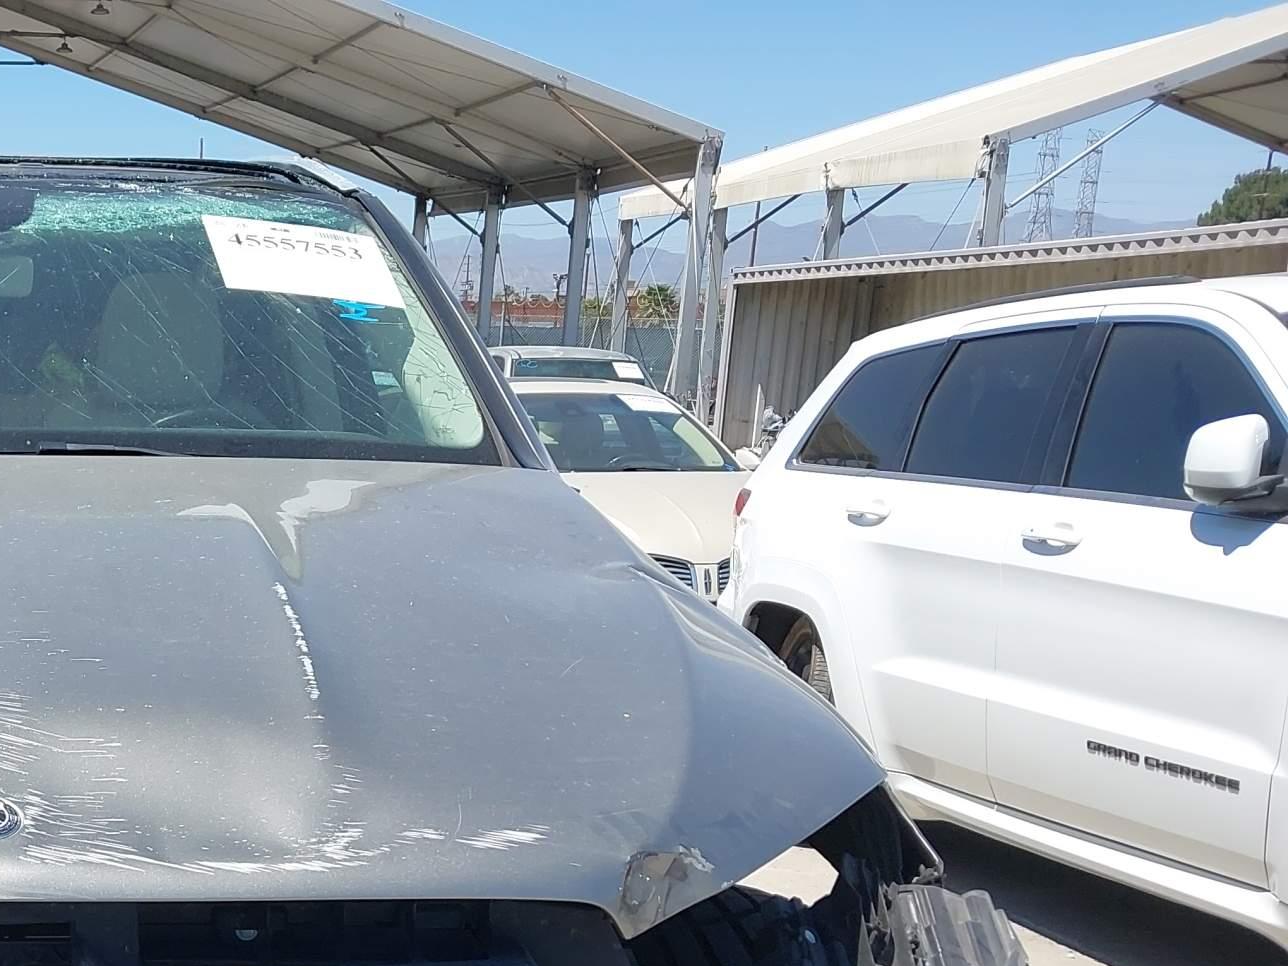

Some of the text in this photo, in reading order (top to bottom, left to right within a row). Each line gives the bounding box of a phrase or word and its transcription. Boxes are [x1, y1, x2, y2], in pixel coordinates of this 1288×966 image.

[227, 233, 363, 260] 45557553
[1086, 740, 1241, 792] GRAND CHEROKEE
